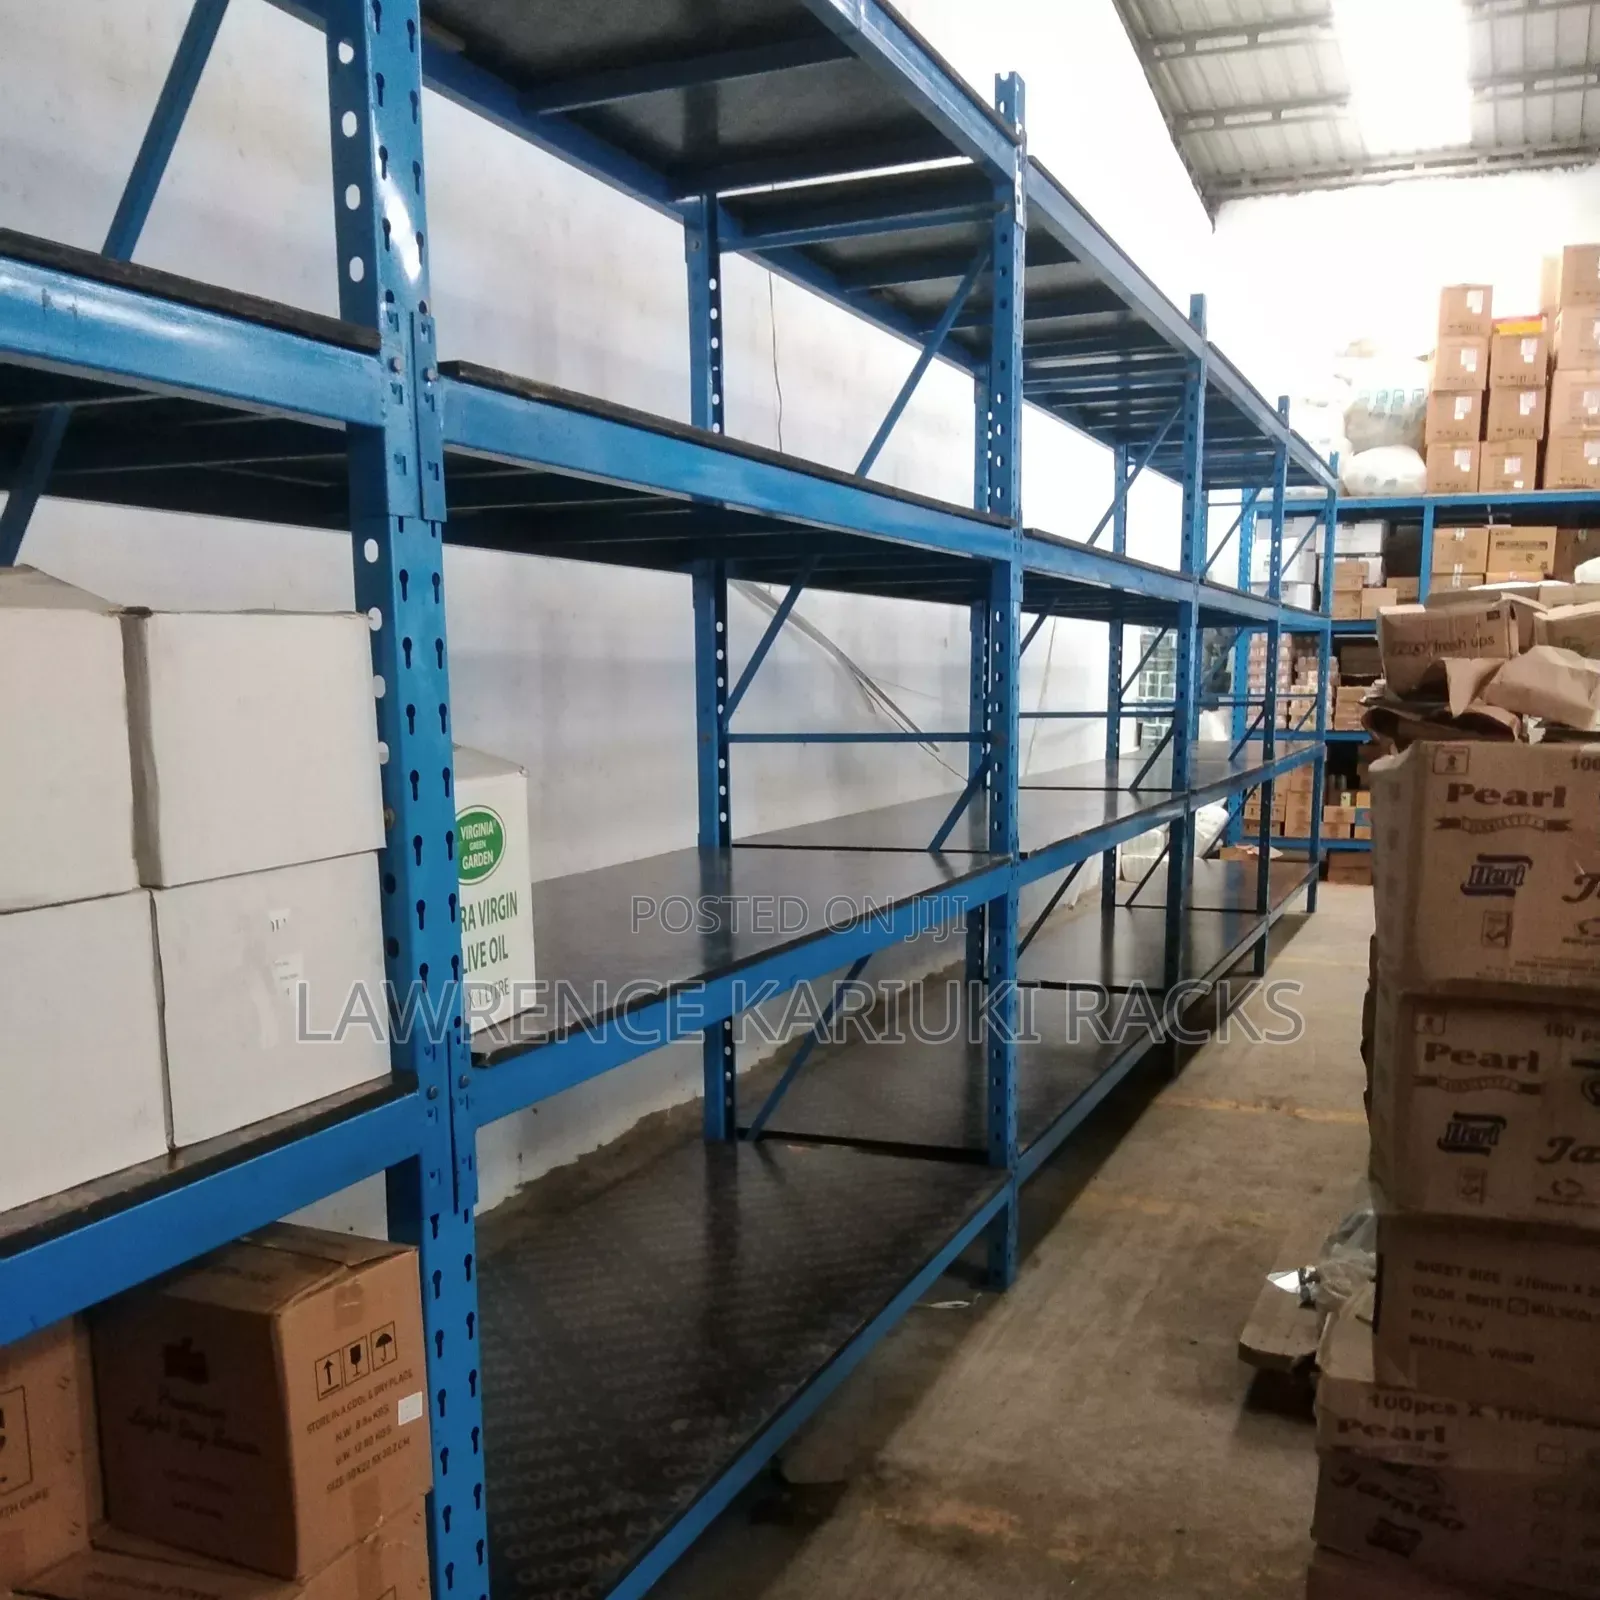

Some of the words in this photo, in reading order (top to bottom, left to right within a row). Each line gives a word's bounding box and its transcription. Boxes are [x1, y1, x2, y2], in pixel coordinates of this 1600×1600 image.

[1446, 782, 1567, 809] Pearl
[460, 820, 494, 841] VIRGINIA
[469, 840, 487, 851] GREEN
[462, 850, 494, 870] GARDEN
[478, 890, 518, 927] VIRGIN
[489, 934, 509, 965] OIL
[1424, 1042, 1539, 1074] Pearl
[306, 1413, 331, 1435] STORE
[388, 1368, 413, 1388] PLACE
[1337, 1418, 1446, 1444] Pearl
